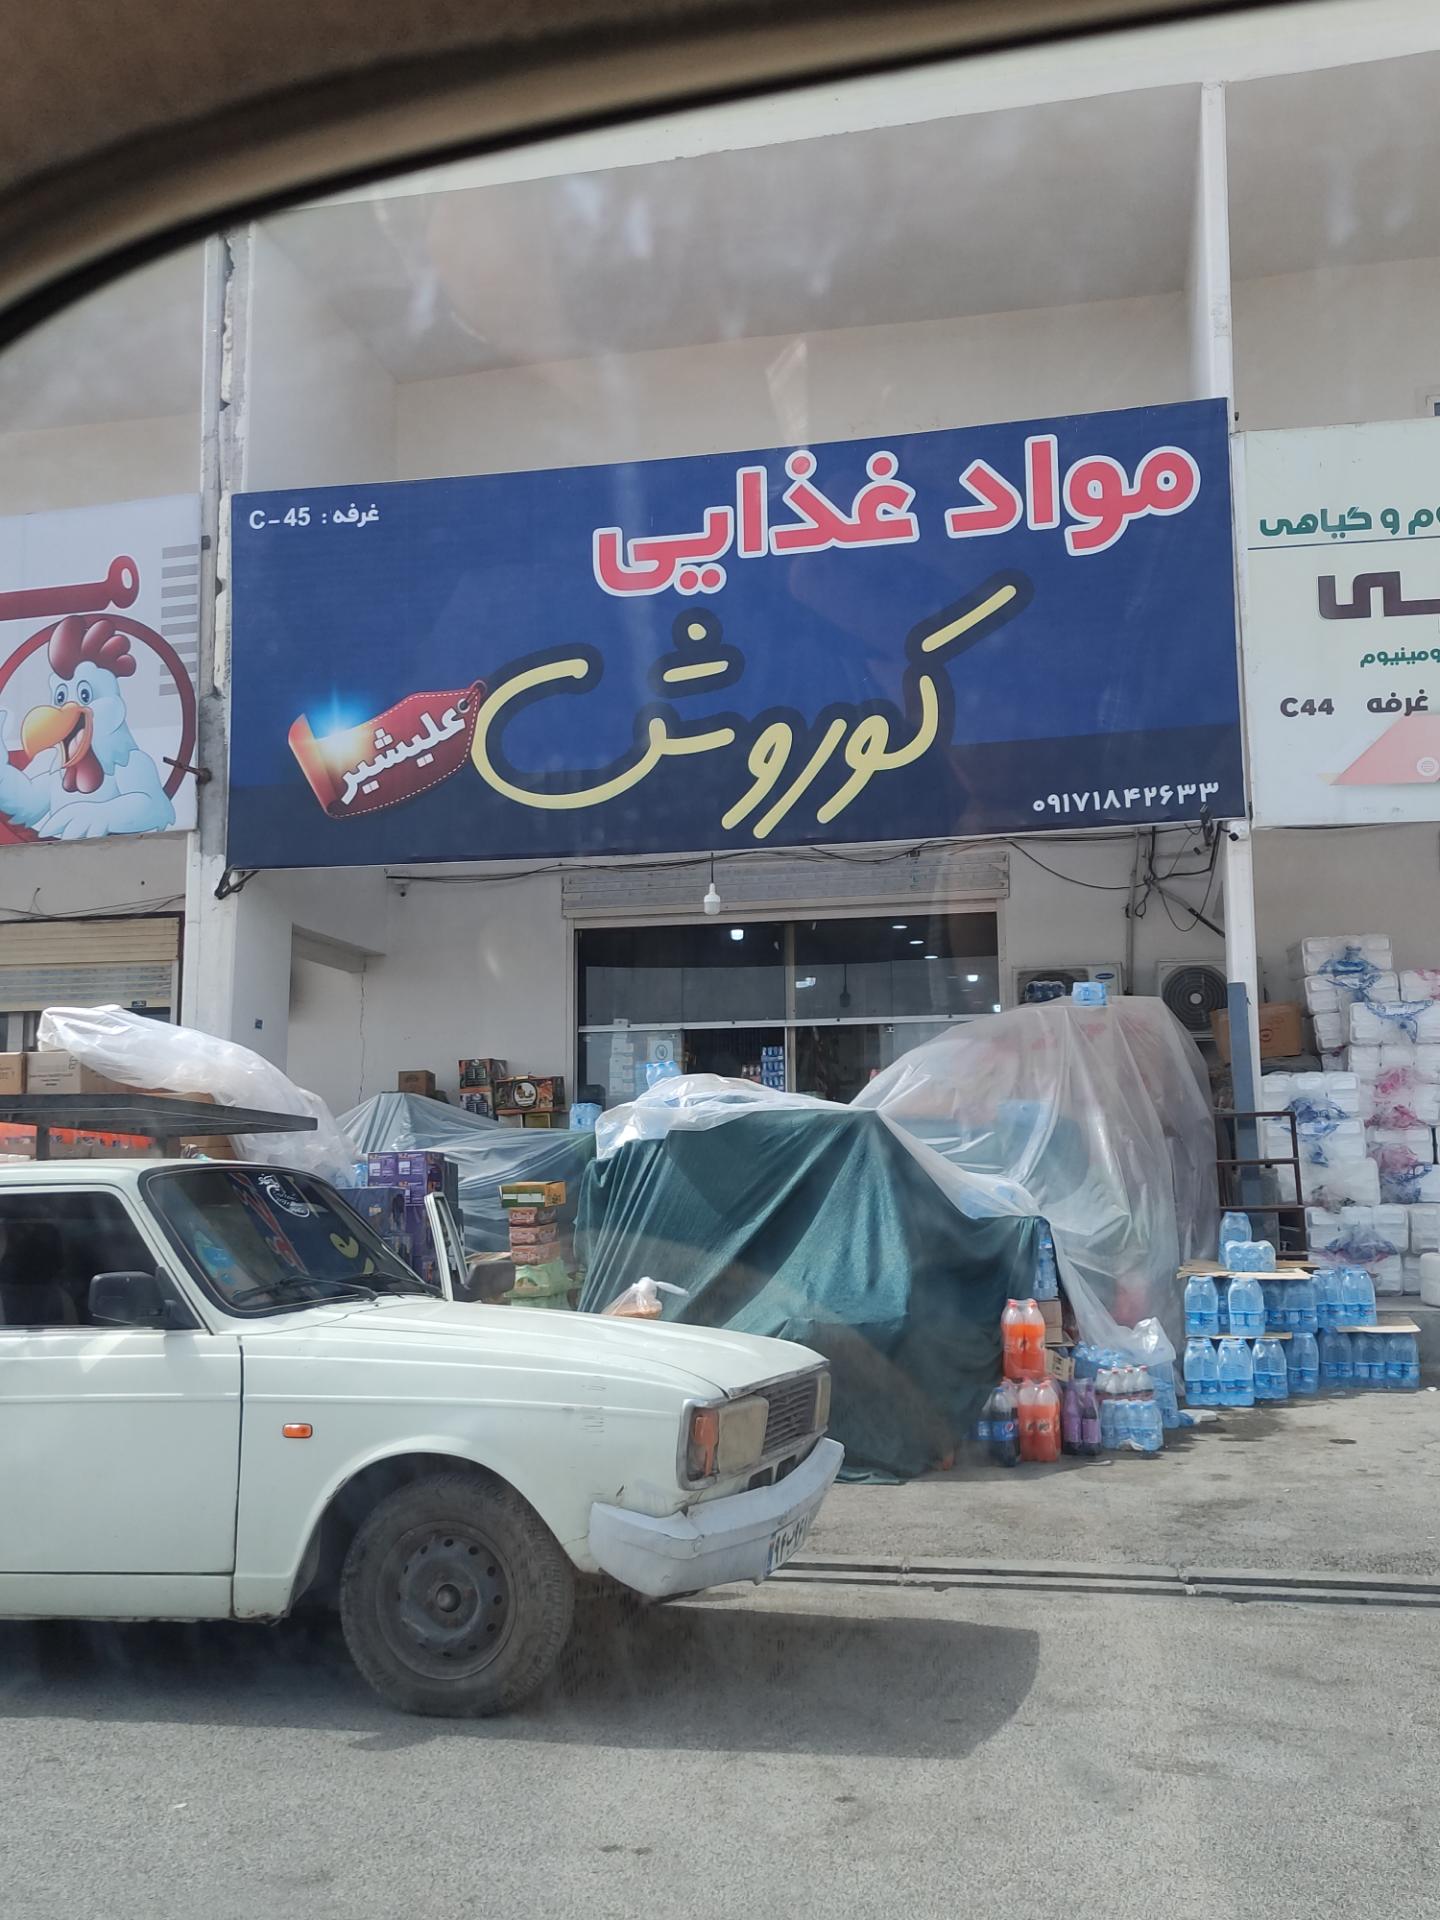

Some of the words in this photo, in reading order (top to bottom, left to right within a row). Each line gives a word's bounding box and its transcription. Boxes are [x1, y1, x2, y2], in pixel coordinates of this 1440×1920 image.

[945, 434, 1201, 556] مواد
[249, 507, 311, 530] C-45
[593, 450, 920, 597] غذایی
[1259, 506, 1373, 540] گیاهی
[1380, 507, 1401, 536] و
[470, 584, 1017, 839] کوروش
[1279, 697, 1335, 718] C44
[1366, 688, 1429, 717] غرفه
[340, 706, 466, 806] علیشیر
[1032, 781, 1220, 814] ۰۹۱۷۱۸۴۲۶۳۳
